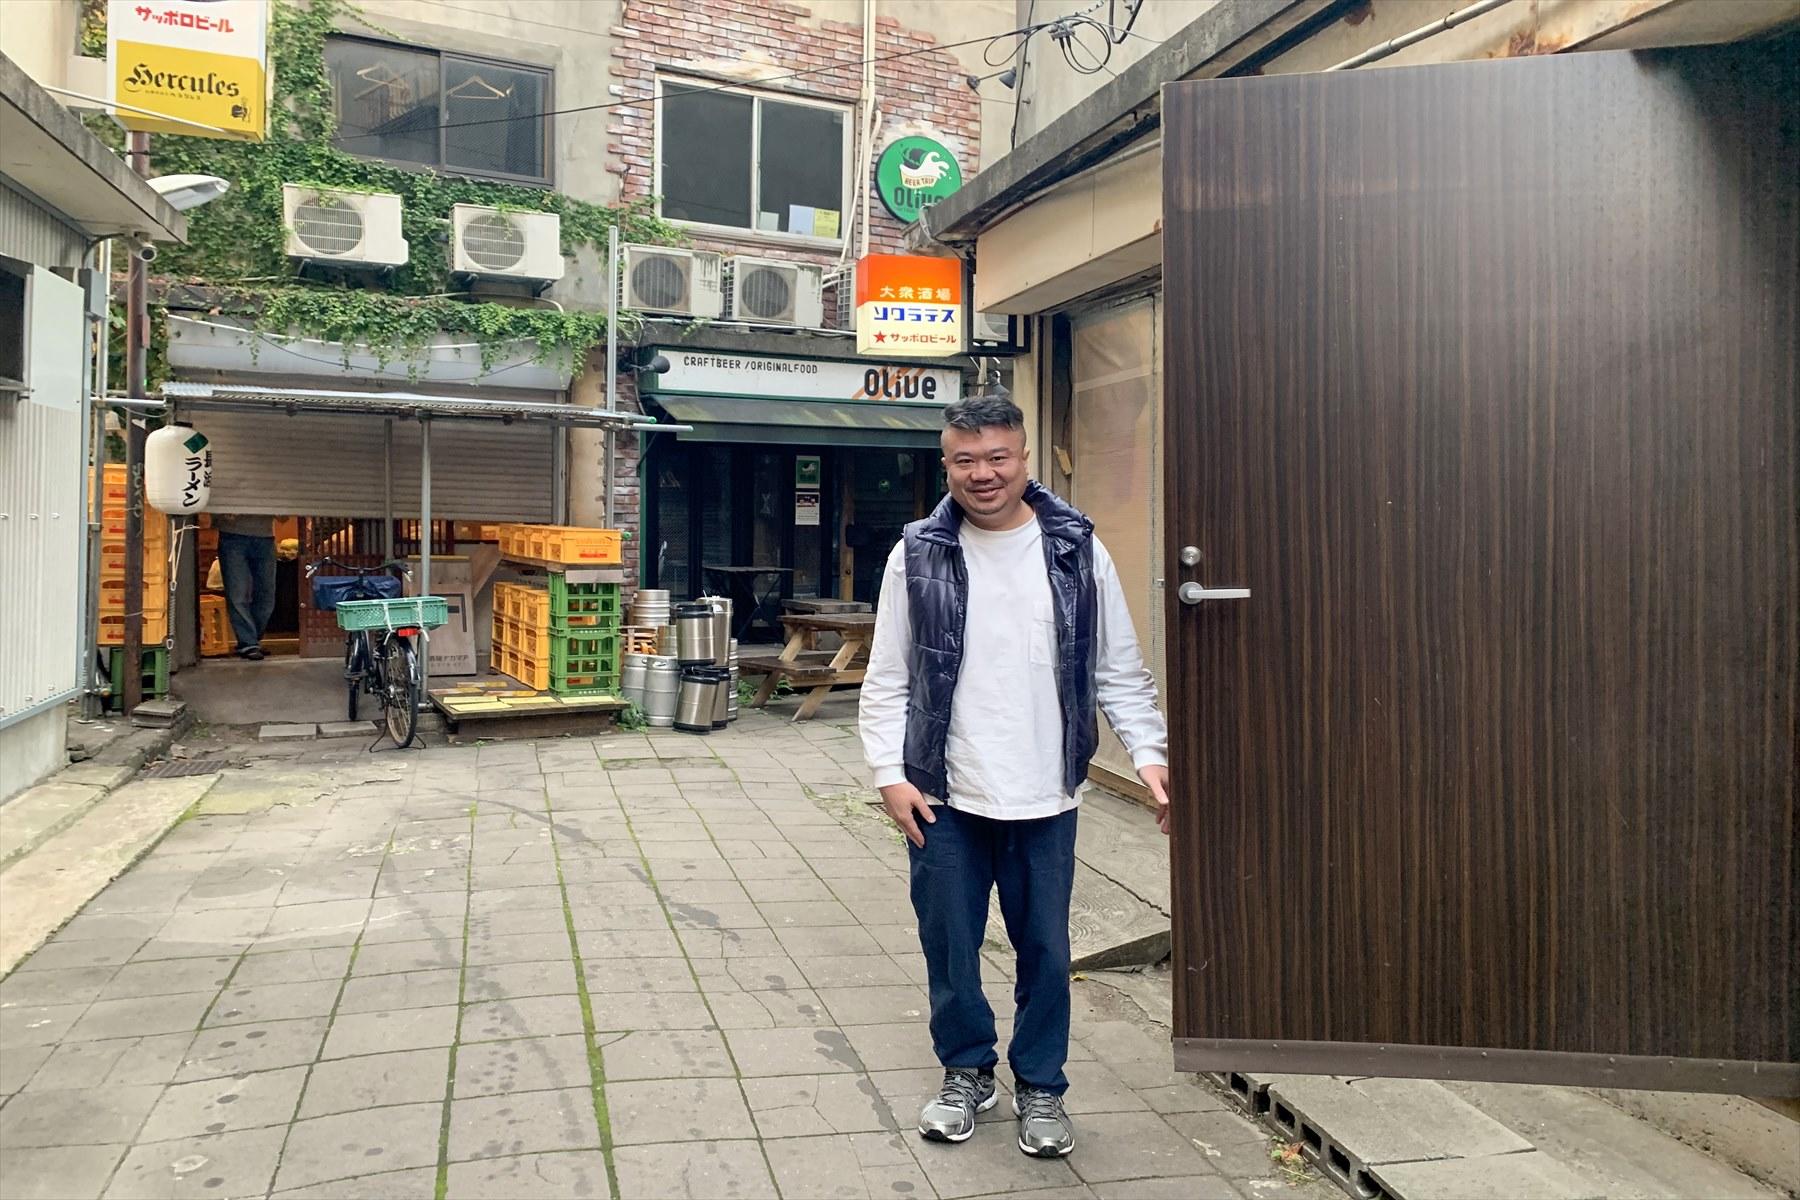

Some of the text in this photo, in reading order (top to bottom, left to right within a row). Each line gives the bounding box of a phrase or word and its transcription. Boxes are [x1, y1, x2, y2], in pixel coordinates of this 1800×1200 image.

[135, 5, 234, 33] サッポロビール
[123, 63, 240, 97] Hercules
[879, 285, 952, 301] 大衆酒場
[873, 306, 955, 323] ソクラテス
[890, 333, 957, 344] サッポロビール
[683, 356, 741, 369] CRAFTBEER
[863, 368, 937, 399] Olive
[182, 456, 203, 507] ラーメン
